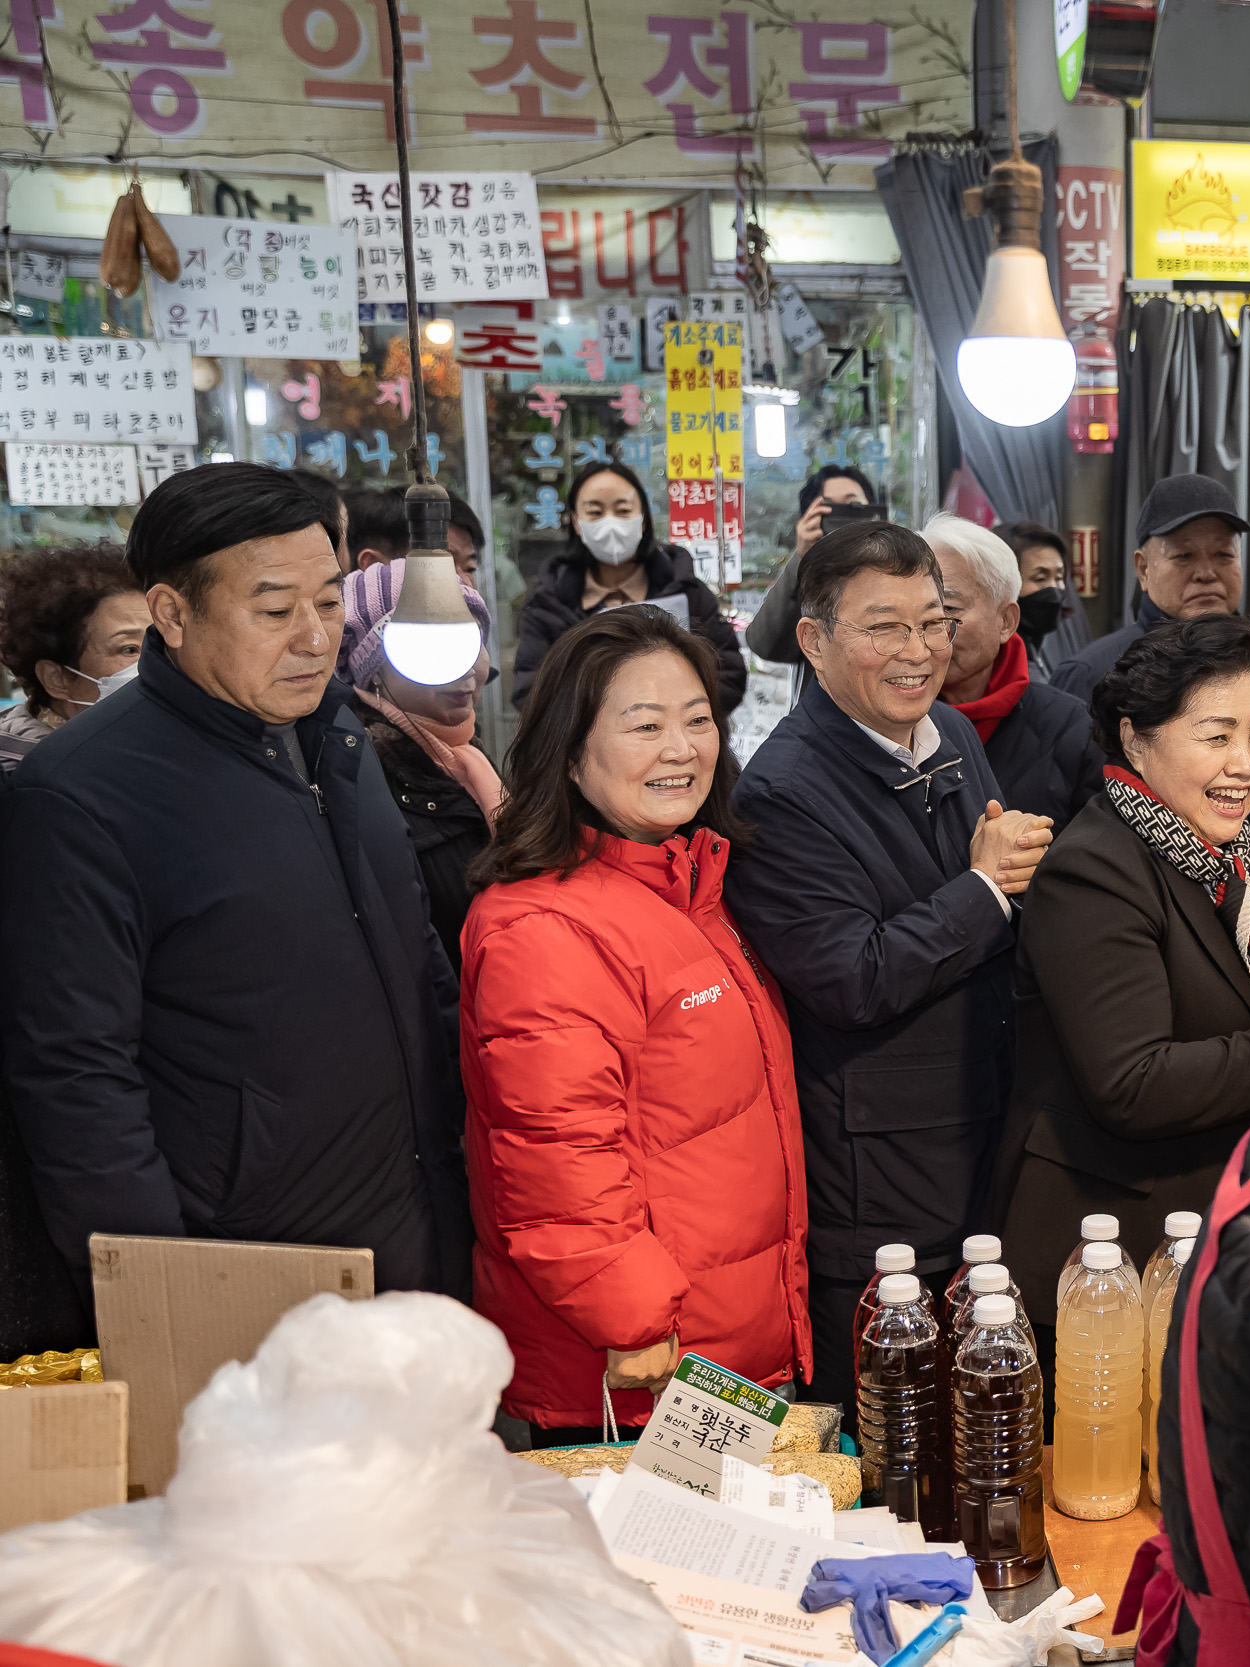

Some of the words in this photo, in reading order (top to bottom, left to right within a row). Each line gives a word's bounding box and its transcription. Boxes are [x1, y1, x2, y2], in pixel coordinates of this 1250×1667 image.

[686, 1372, 722, 1396] 정직하게
[720, 1388, 772, 1419] 표시했습니다
[691, 1363, 738, 1391] 우리가게는
[739, 1385, 777, 1410] 원산지를
[663, 1413, 690, 1431] 원산지
[692, 1428, 731, 1454] 국산
[719, 1602, 759, 1621] 유용한
[763, 1611, 815, 1632] 생활정보
